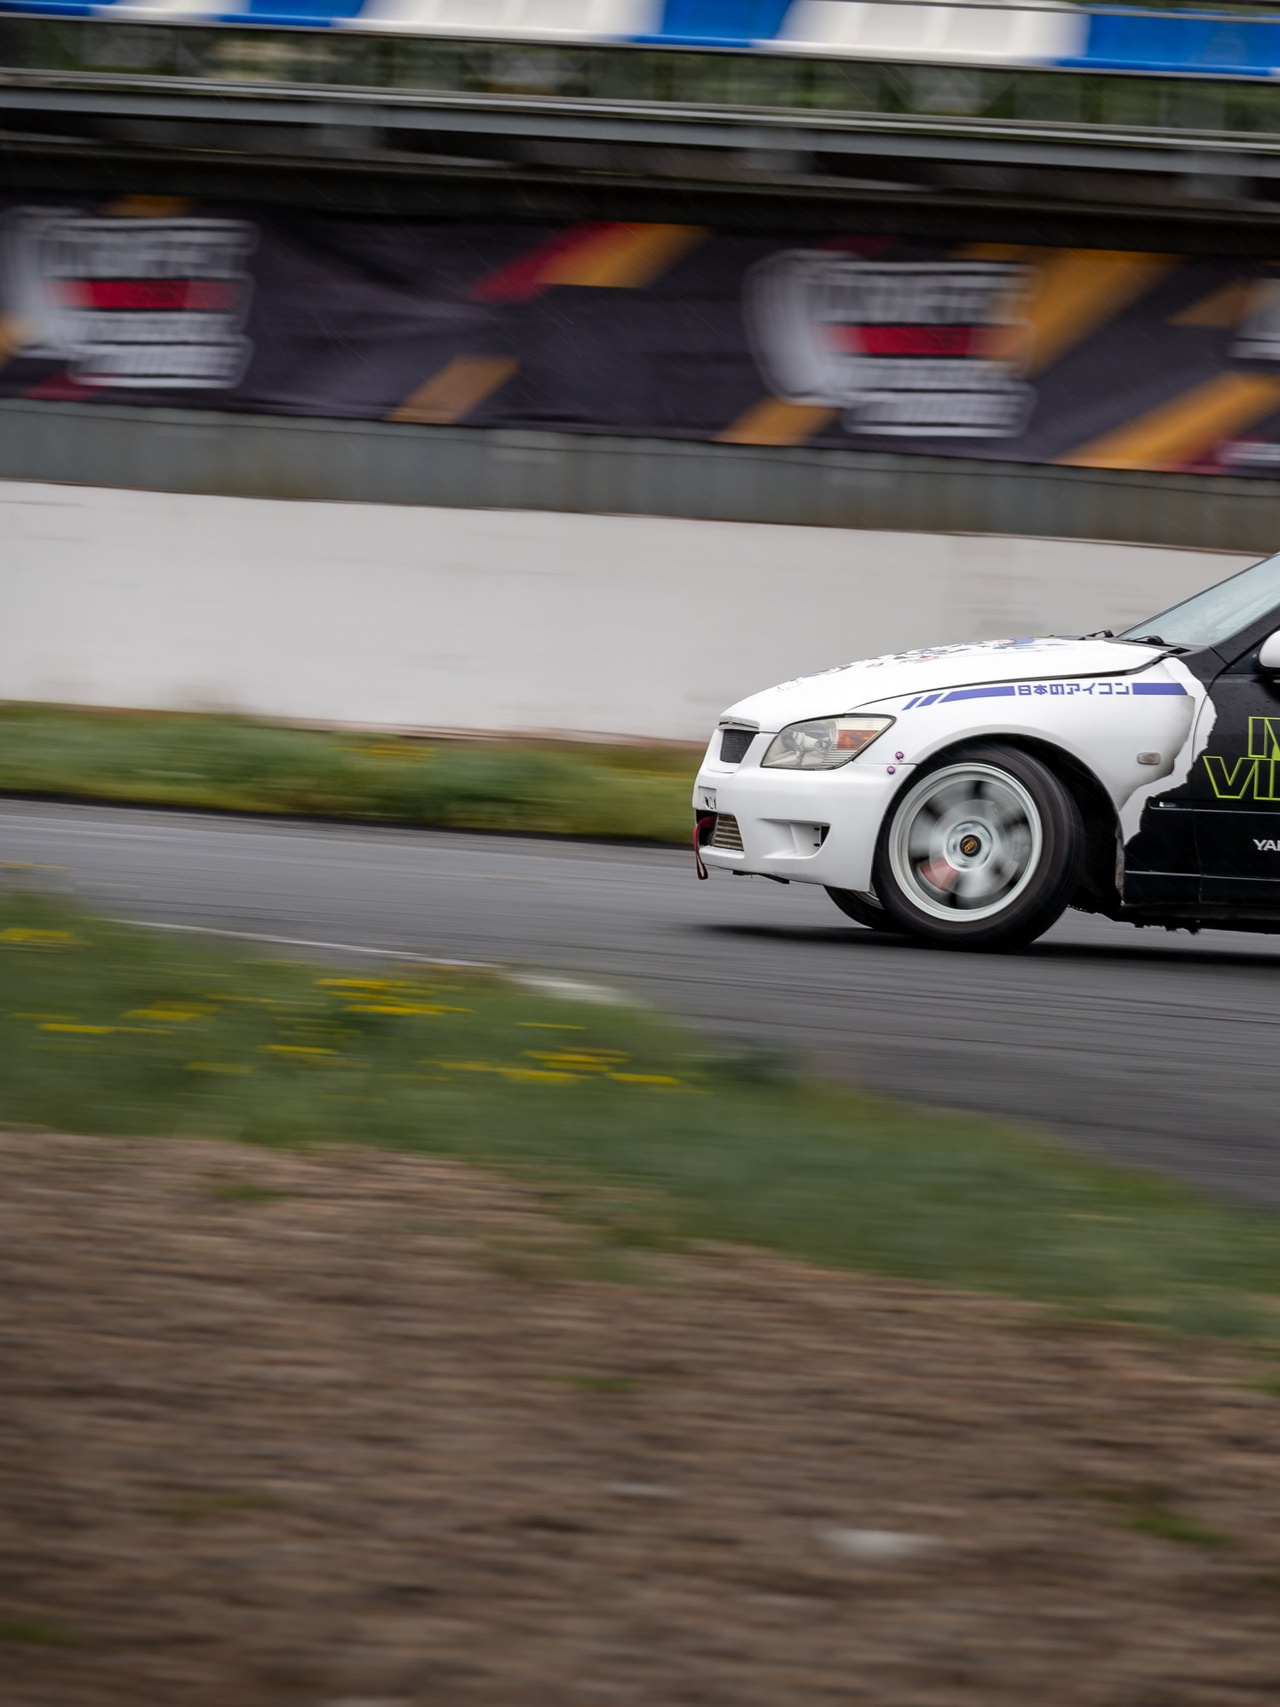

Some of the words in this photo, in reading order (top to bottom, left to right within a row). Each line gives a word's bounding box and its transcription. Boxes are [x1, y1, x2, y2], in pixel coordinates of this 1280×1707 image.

[1018, 682, 1130, 696] 日本のアイコン
